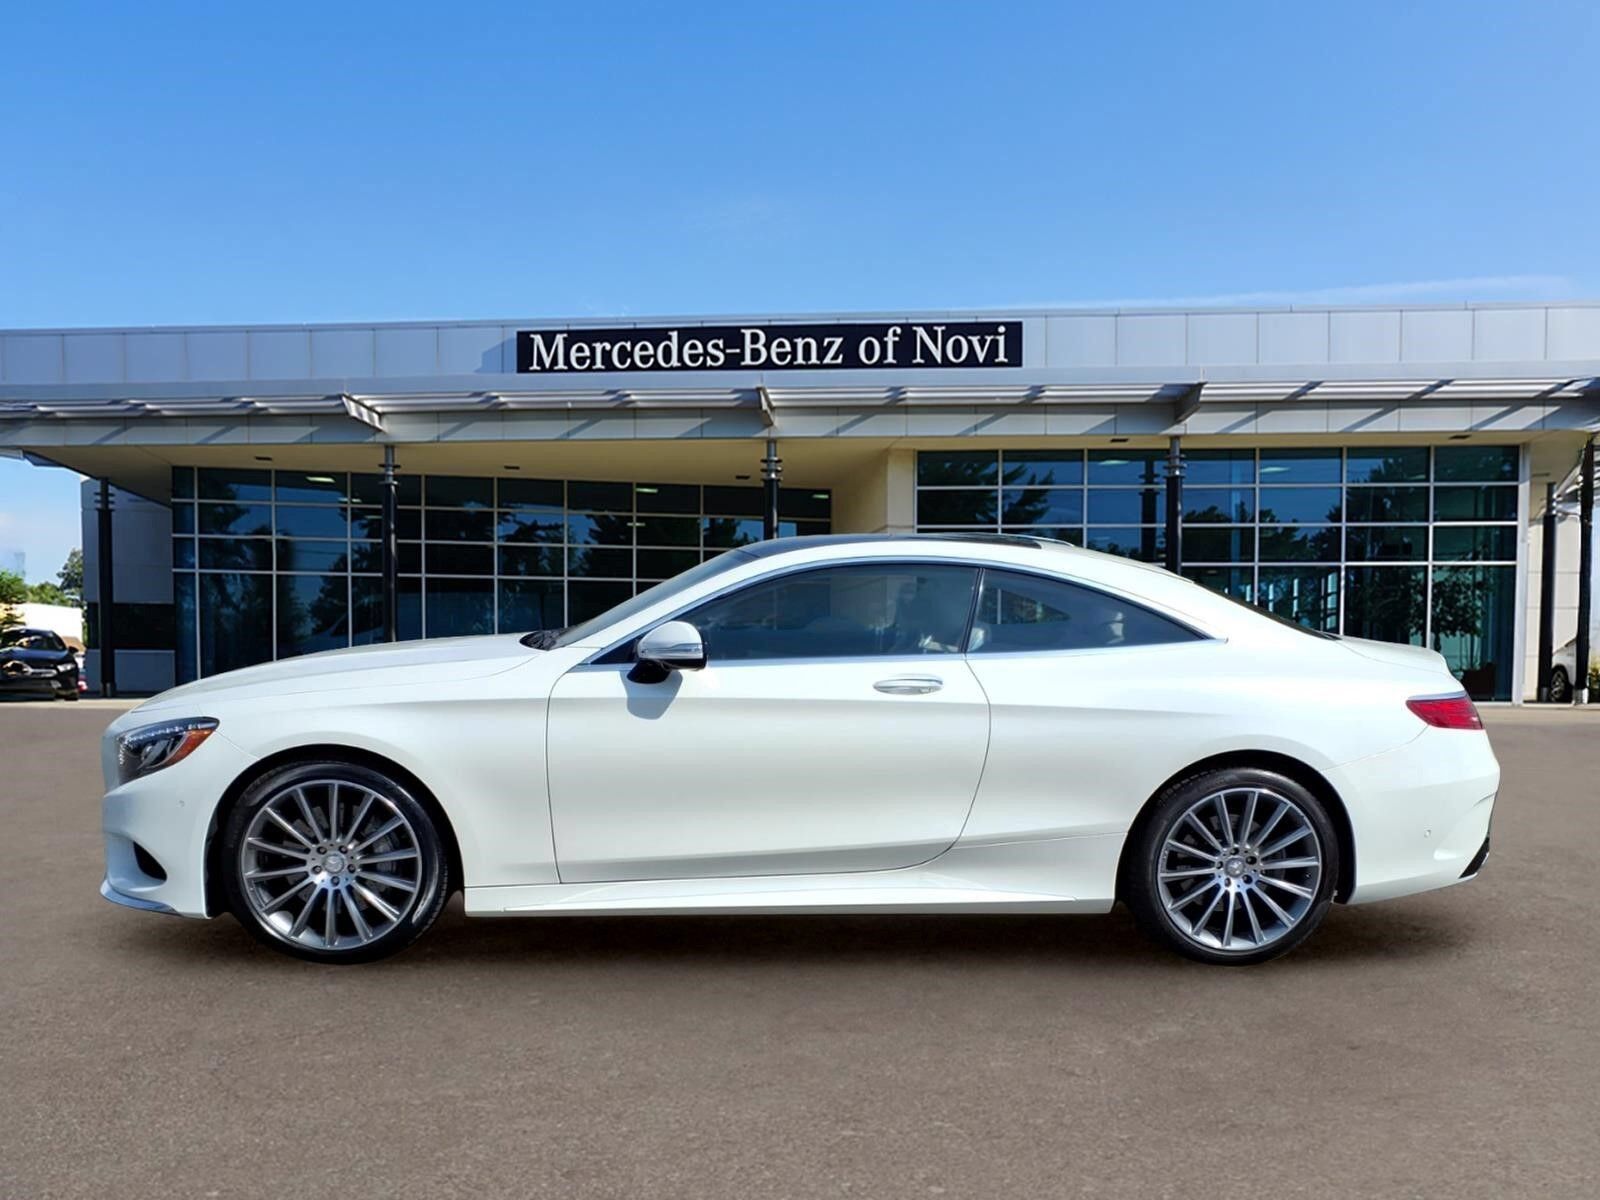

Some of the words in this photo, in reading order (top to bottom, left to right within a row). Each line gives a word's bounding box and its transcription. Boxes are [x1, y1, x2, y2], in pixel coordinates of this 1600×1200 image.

[528, 328, 843, 371] Mercedes-Benz
[858, 326, 902, 364] of
[912, 325, 1009, 364] Novi
